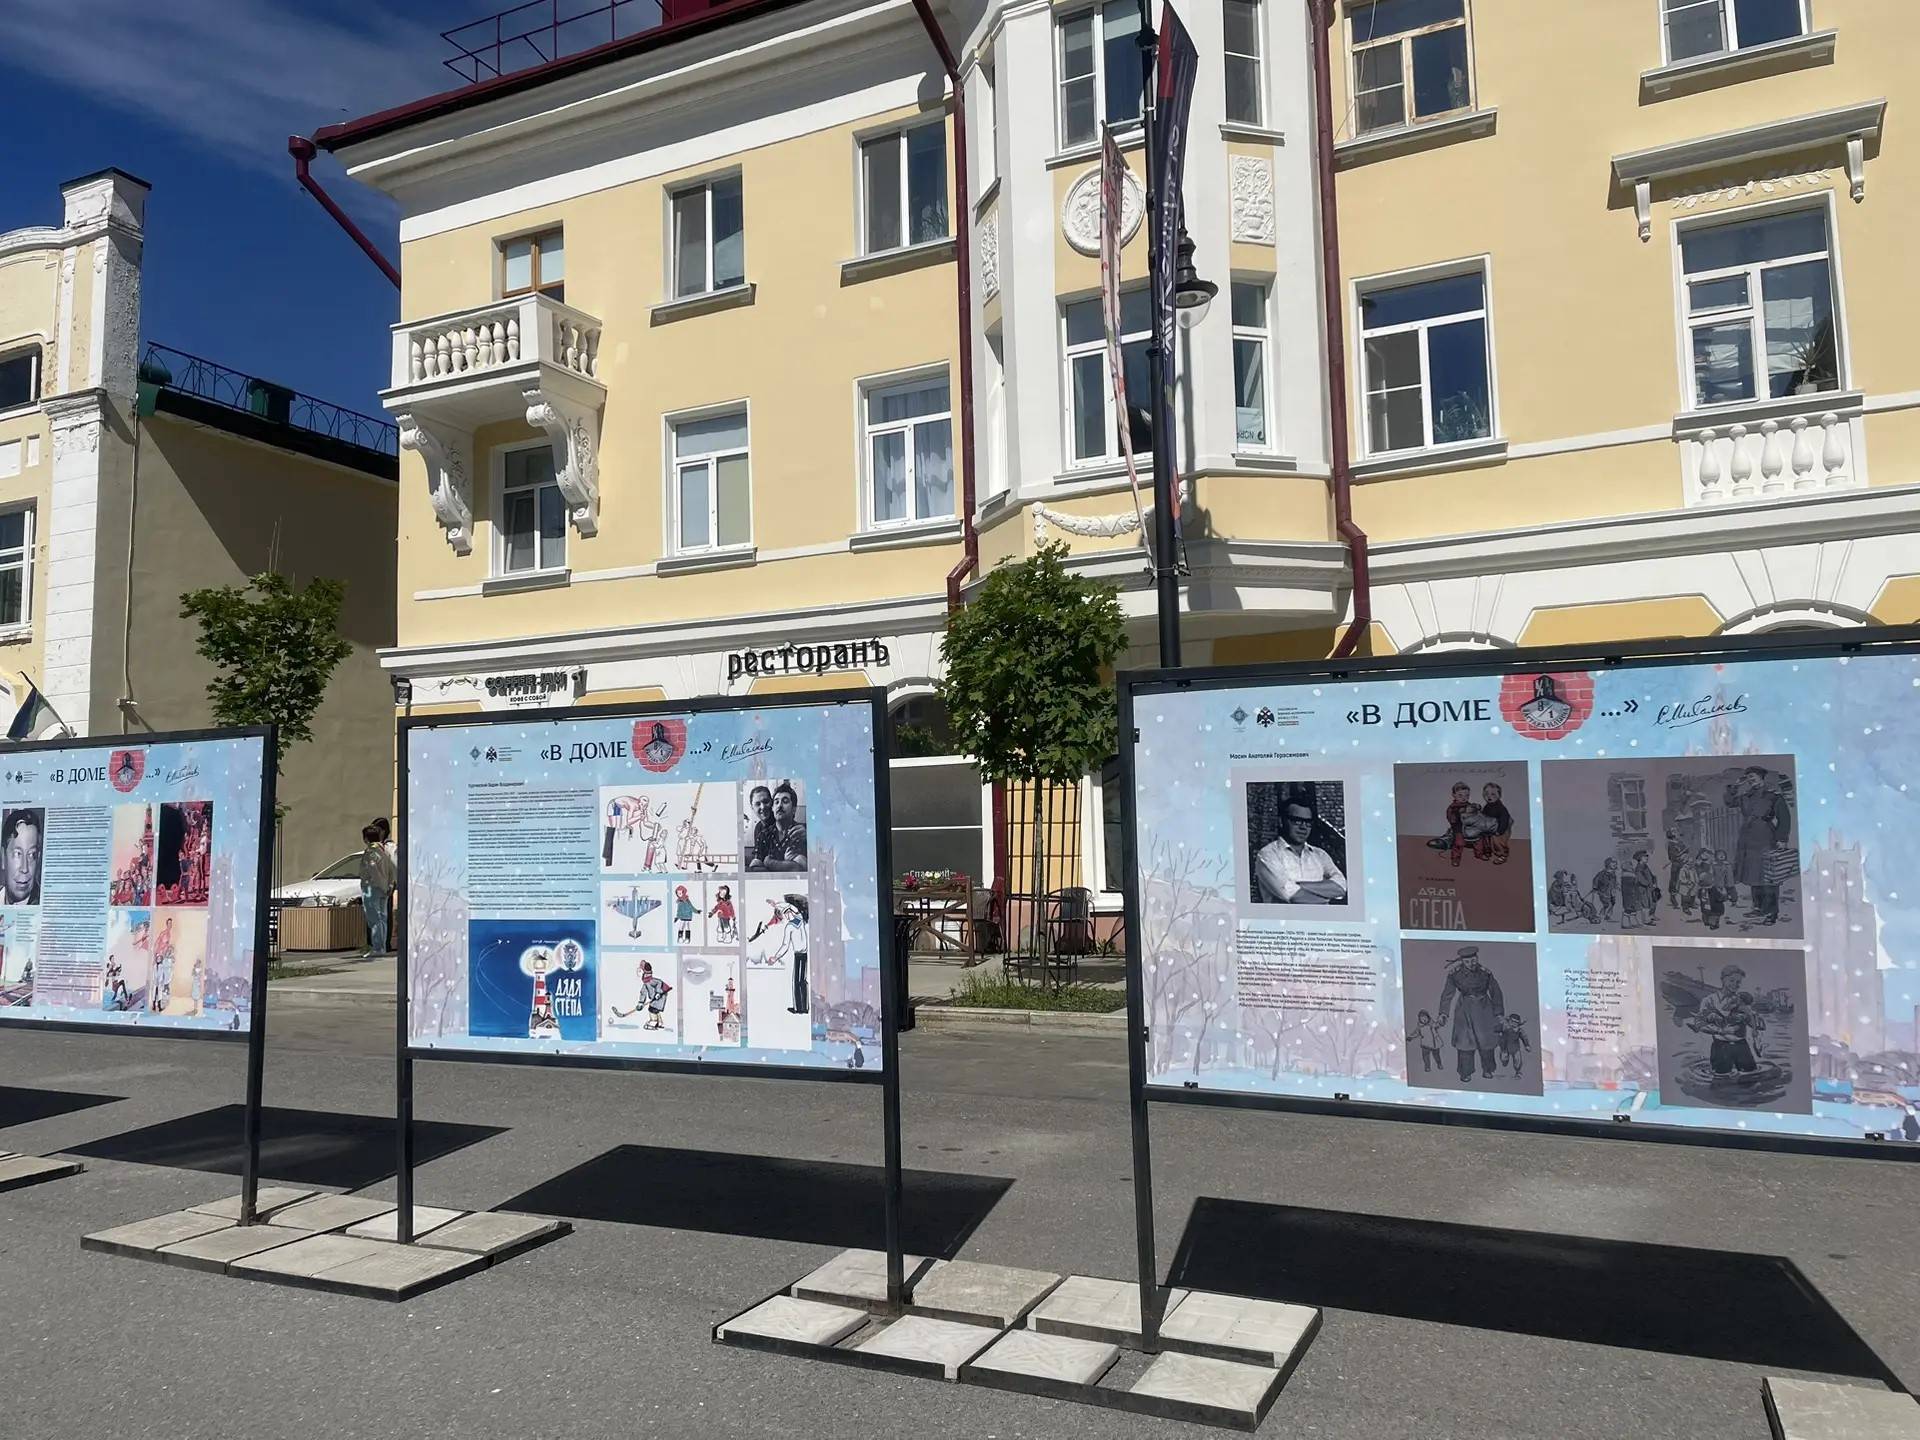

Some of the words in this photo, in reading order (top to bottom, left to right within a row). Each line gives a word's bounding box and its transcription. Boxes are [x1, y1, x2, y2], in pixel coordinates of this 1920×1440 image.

[728, 640, 889, 680] ресторанъ
[1394, 699, 1491, 728] ДОМЕ
[569, 741, 627, 763] ДОМЕ
[68, 766, 106, 784] ДОМЕ
[1409, 898, 1467, 930] СТЕПА
[555, 978, 582, 998] ДЯДЯ
